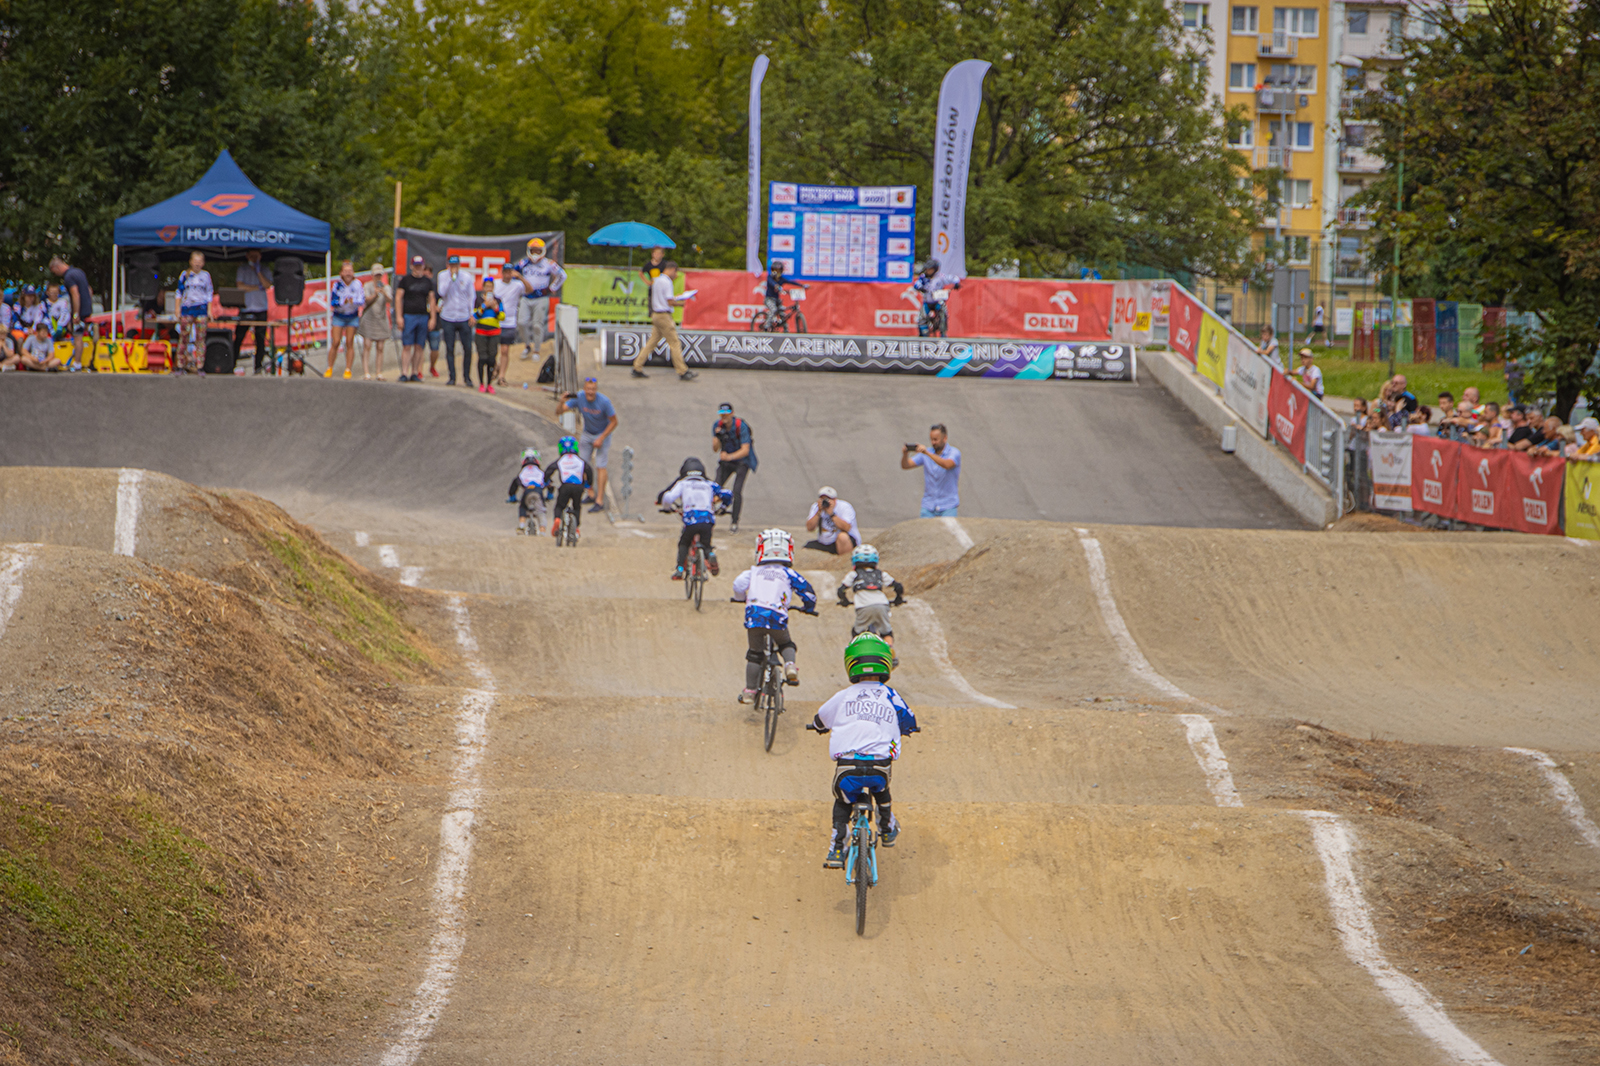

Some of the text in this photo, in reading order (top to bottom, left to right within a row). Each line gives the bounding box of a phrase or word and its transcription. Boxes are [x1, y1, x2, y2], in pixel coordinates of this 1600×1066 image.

[187, 228, 290, 244] HUTCHINSON
[1028, 316, 1074, 329] ORLEN
[711, 336, 774, 354] PARK
[779, 337, 861, 357] ARENA
[866, 339, 1043, 361] DZIERŻONIÓW
[846, 701, 894, 723] KOSIOR
